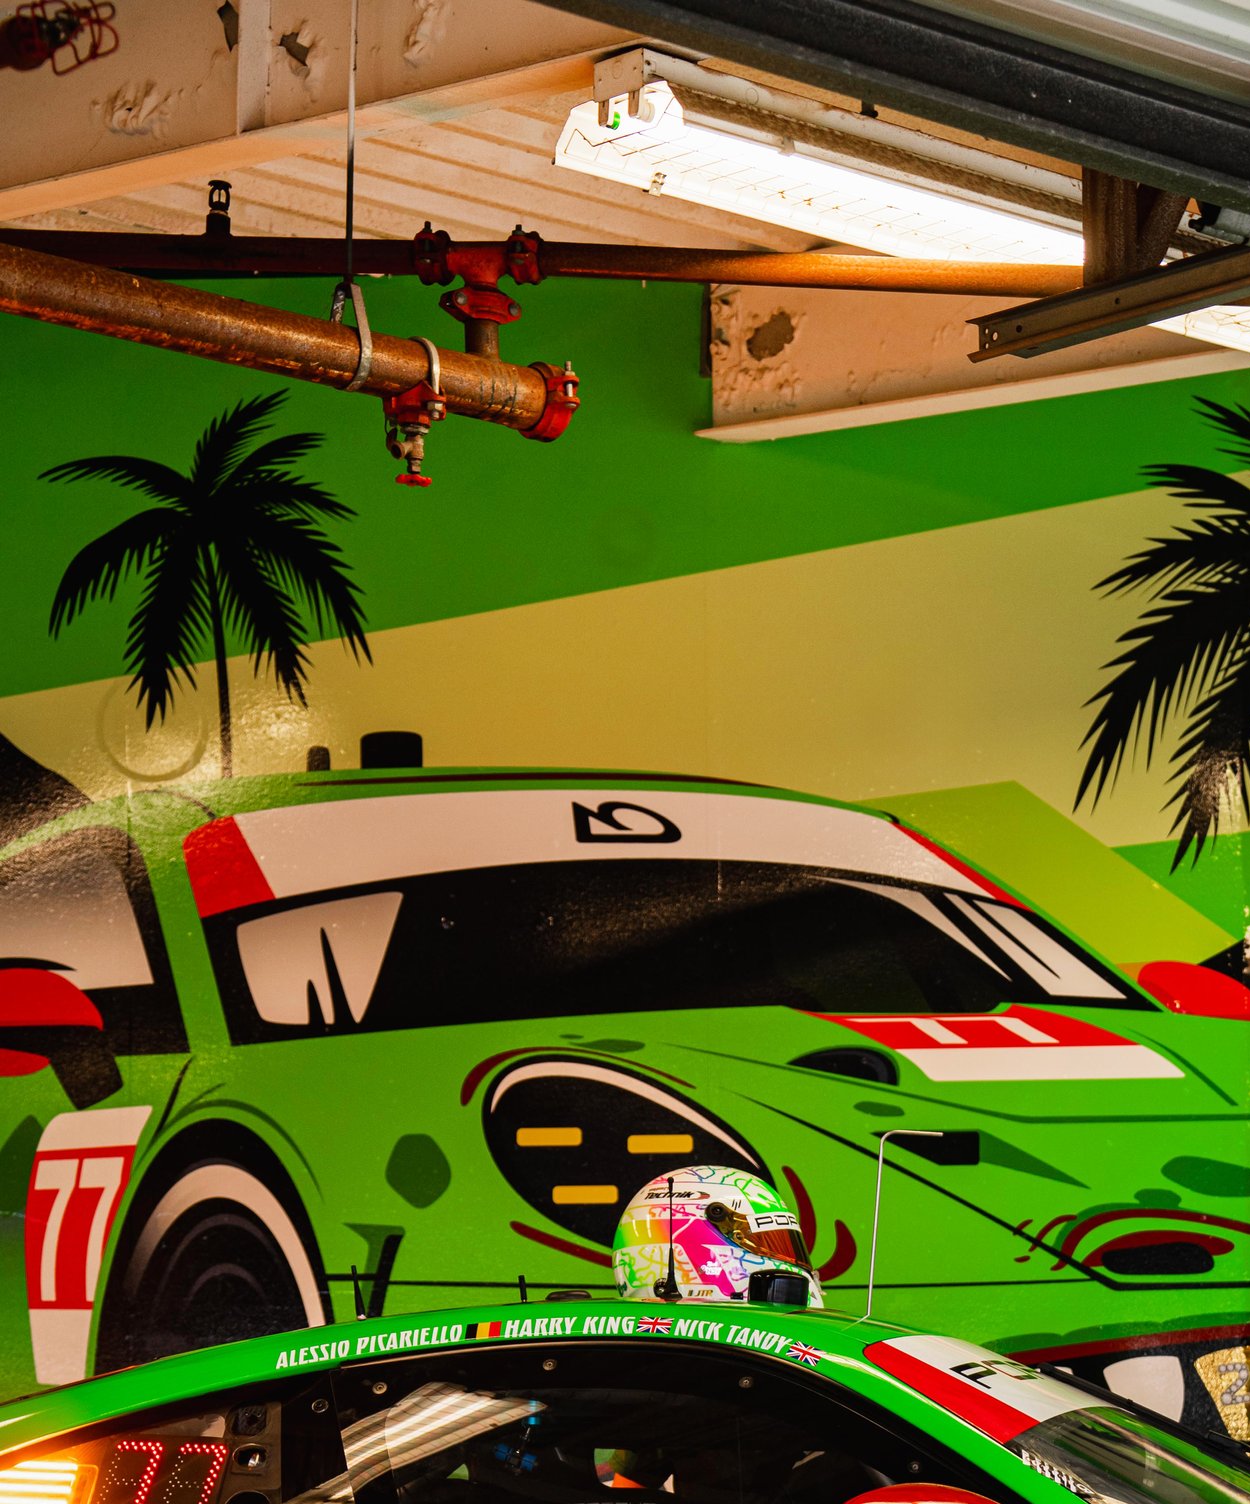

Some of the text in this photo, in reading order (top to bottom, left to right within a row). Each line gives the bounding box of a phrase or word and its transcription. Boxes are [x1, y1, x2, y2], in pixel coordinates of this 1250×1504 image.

[33, 1156, 125, 1302] 77
[275, 1324, 463, 1370] ALESSIO PICARIELLO
[504, 1316, 636, 1338] HARRY KING
[673, 1319, 790, 1355] NICK TANDY
